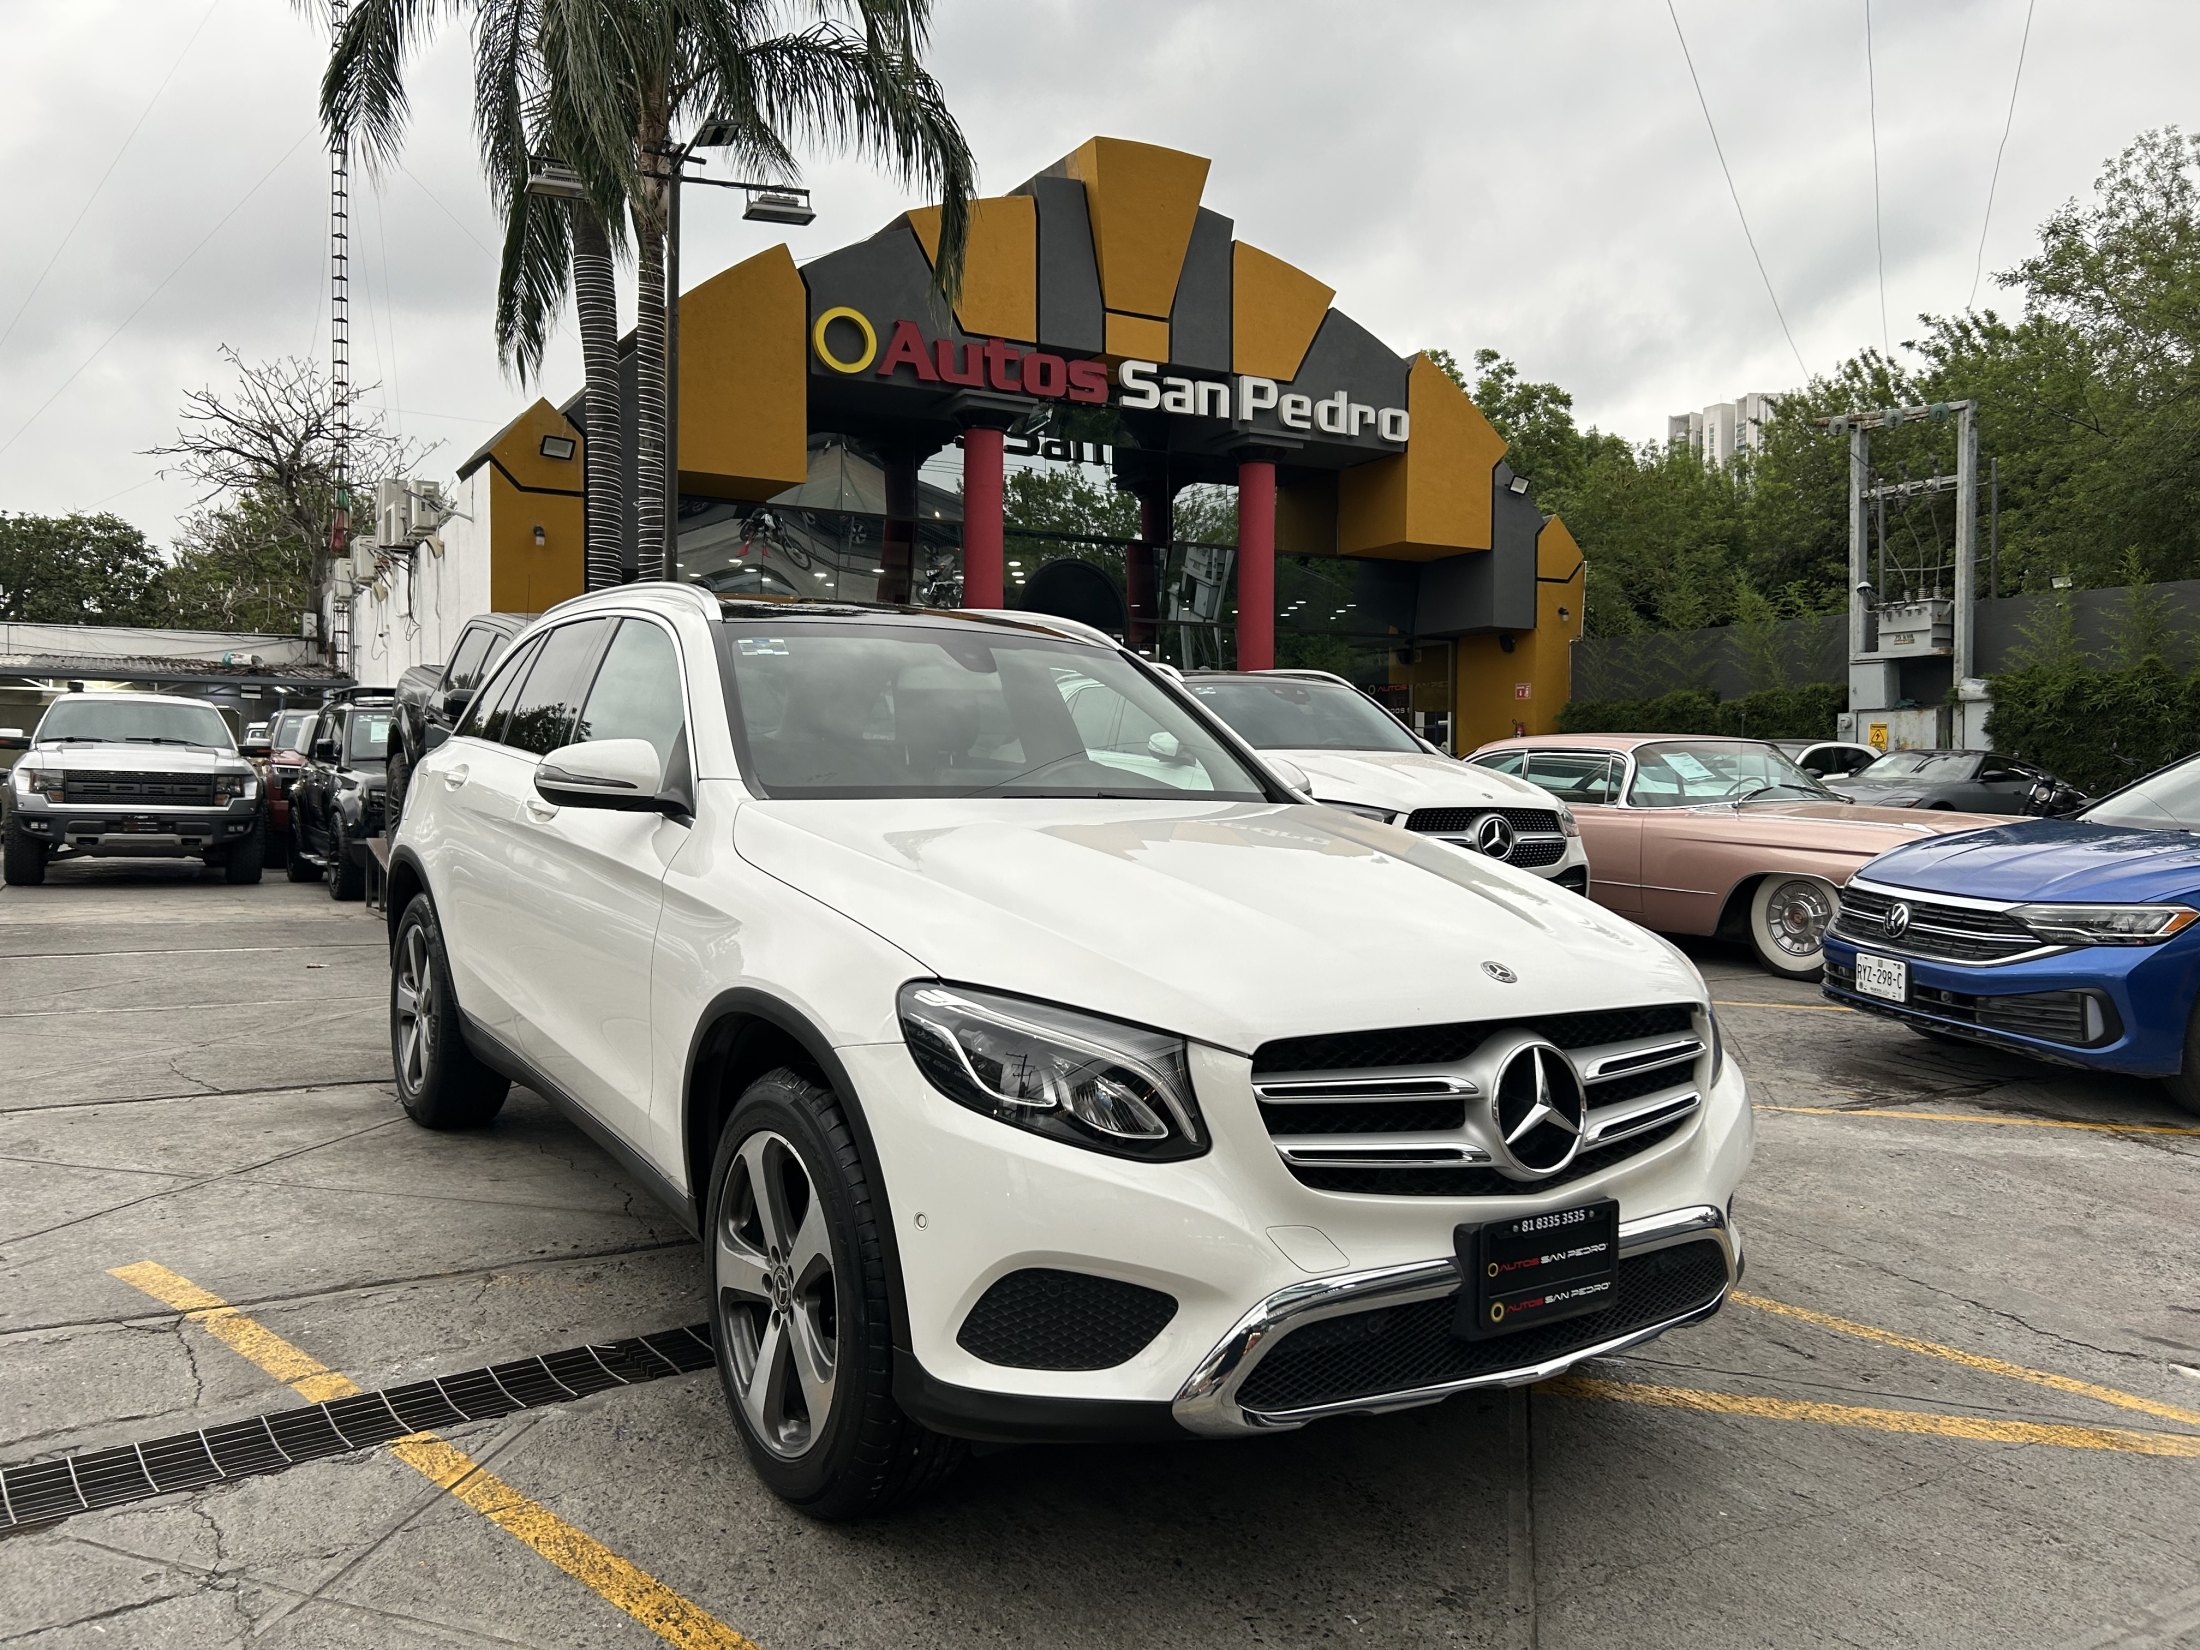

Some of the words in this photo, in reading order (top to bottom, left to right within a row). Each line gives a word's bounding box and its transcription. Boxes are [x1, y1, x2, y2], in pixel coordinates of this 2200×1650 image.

[877, 319, 1108, 403] Autos
[1118, 360, 1230, 419] San
[1238, 375, 1411, 443] Pedro
[1857, 964, 1902, 989] RYZ-298-C
[1521, 1219, 1534, 1233] 81
[1536, 1214, 1561, 1229] 8335
[1562, 1209, 1586, 1225] 3535
[1499, 1257, 1540, 1273] AUTOS
[1540, 1251, 1566, 1264] SAN
[1567, 1243, 1607, 1259] PEDRO
[1506, 1298, 1545, 1314] AUTOS
[1544, 1291, 1570, 1304] SAN
[1571, 1282, 1610, 1297] PEDRO
